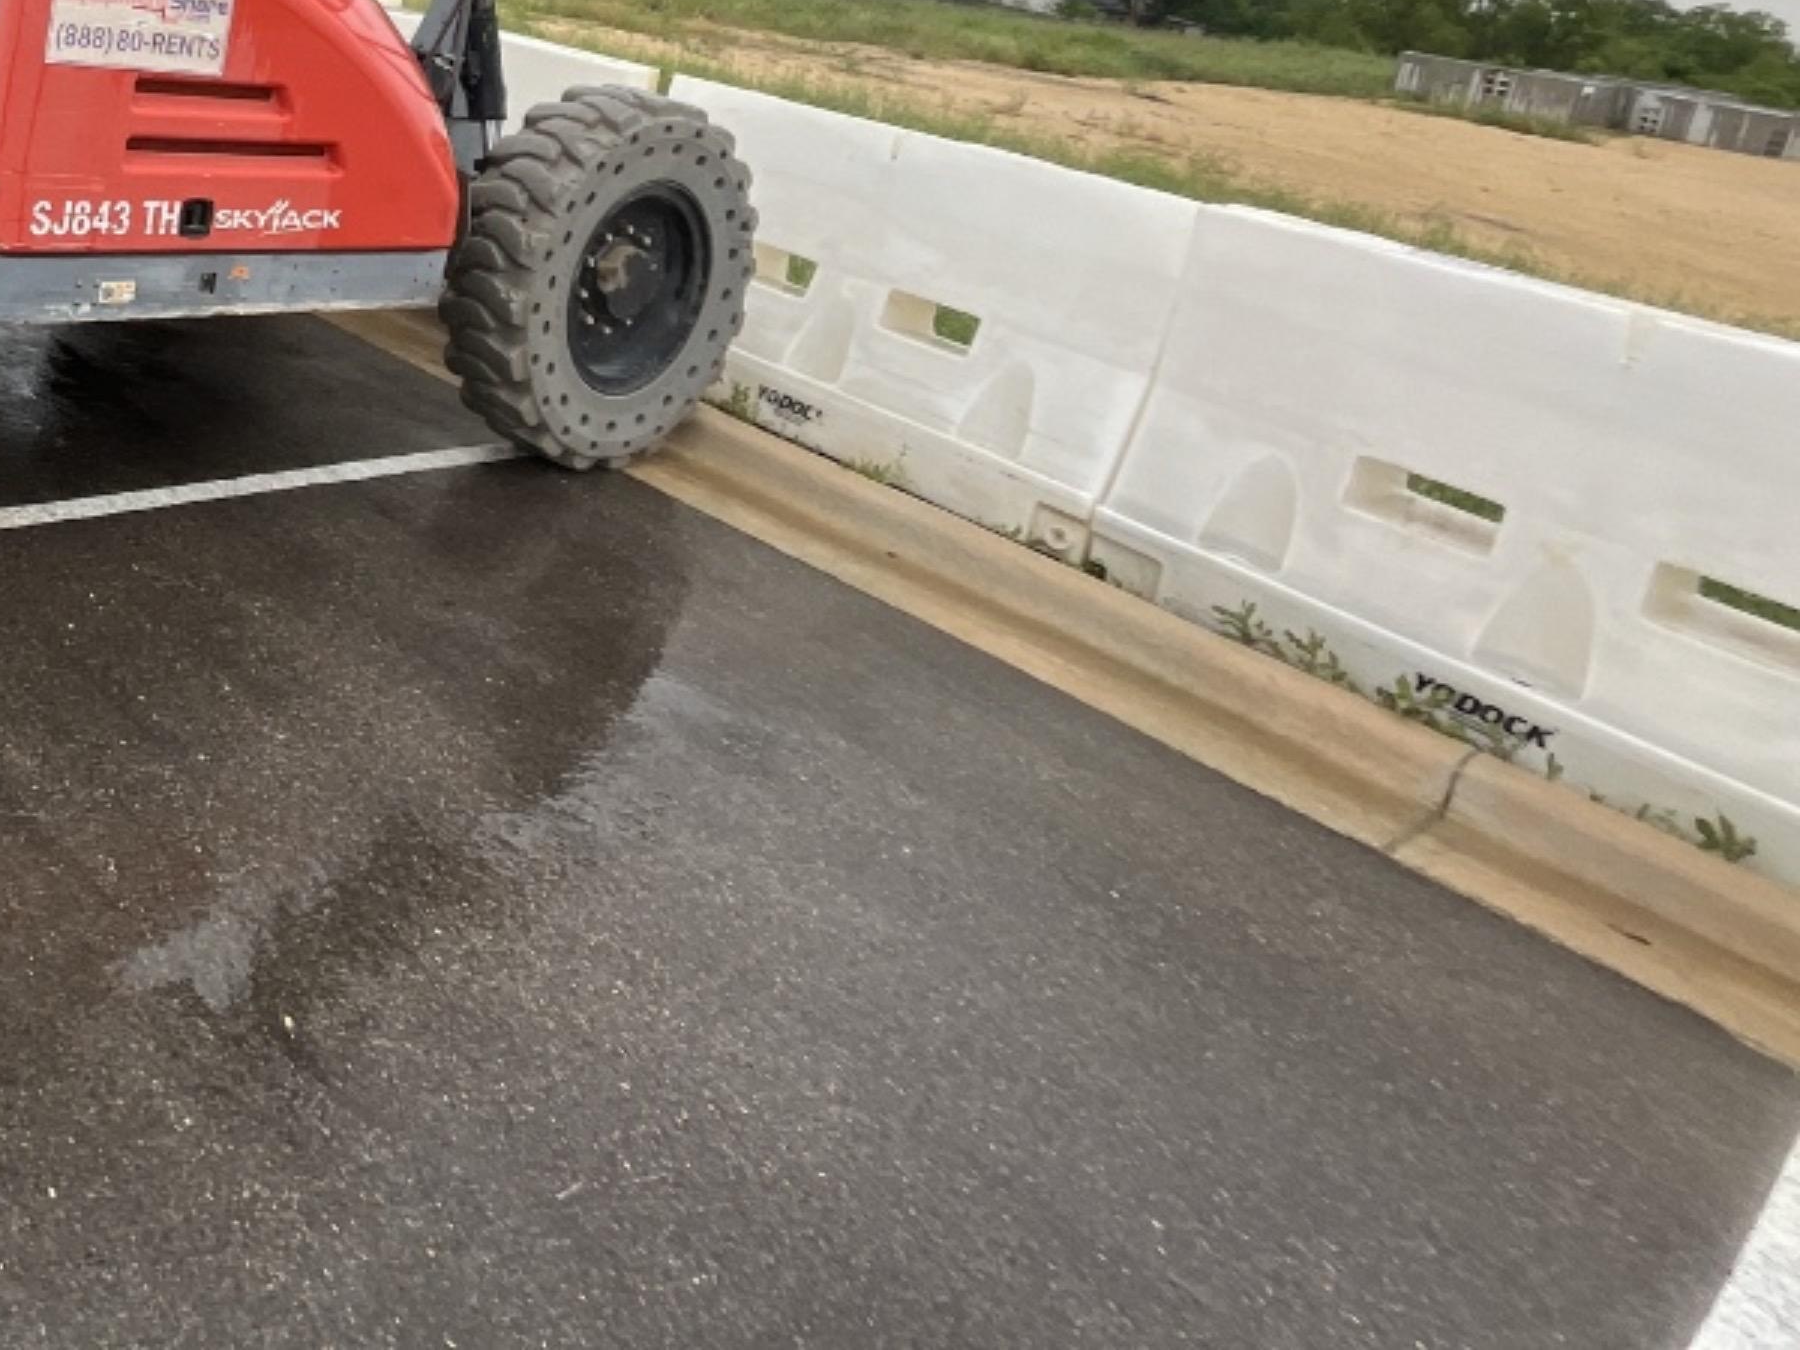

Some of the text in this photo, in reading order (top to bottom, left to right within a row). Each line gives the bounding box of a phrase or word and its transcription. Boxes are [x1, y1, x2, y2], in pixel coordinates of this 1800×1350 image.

[30, 199, 342, 236] SJ843 TH SKYJACK
[1415, 671, 1554, 749] YODOCK
